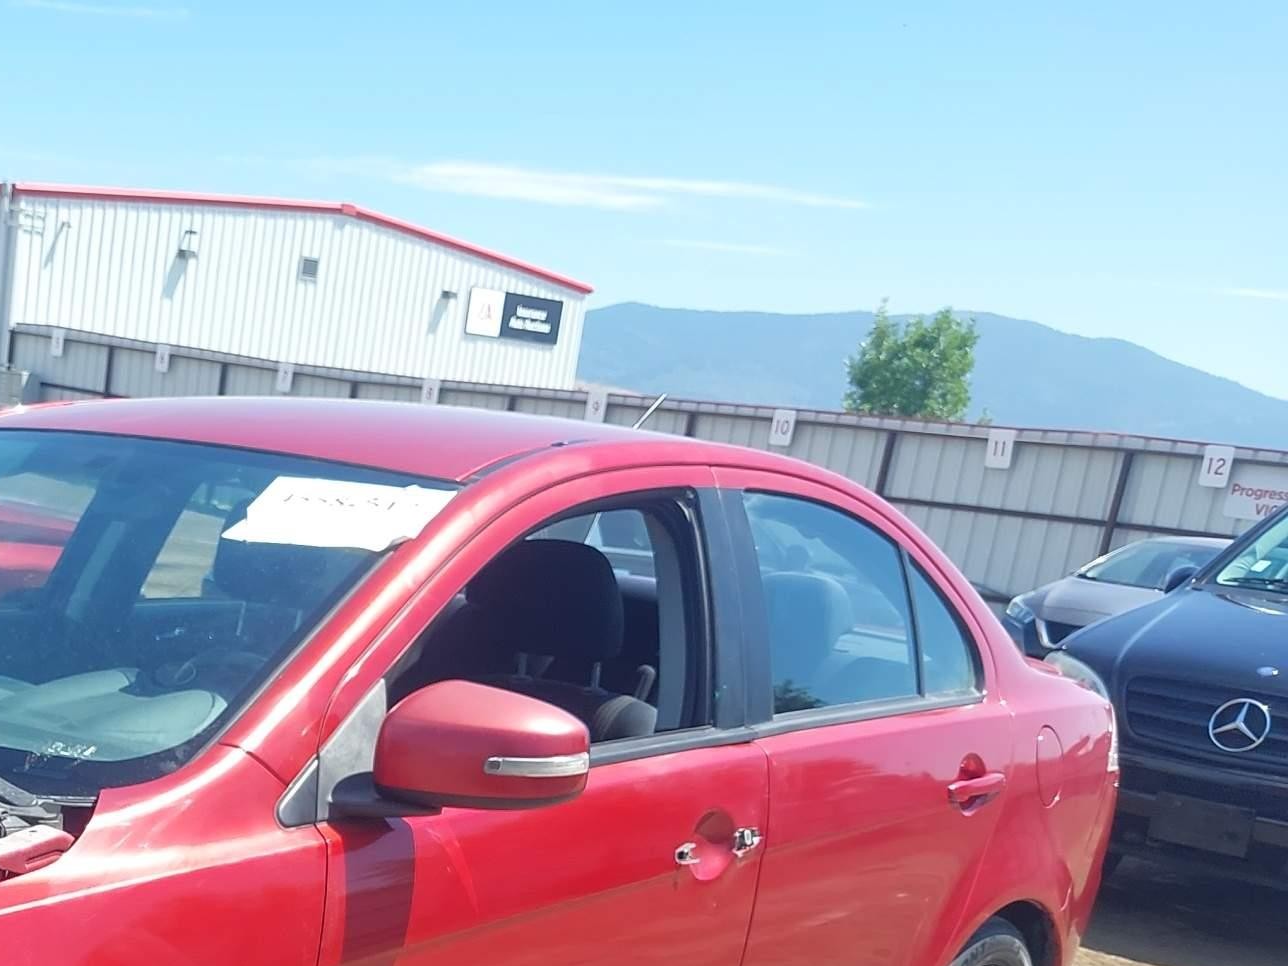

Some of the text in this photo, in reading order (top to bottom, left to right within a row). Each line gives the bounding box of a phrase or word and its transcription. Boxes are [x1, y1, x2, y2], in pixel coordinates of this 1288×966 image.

[775, 417, 791, 436] 10
[993, 440, 1007, 457] 11
[1207, 457, 1227, 476] 12
[1231, 483, 1288, 501] Progress
